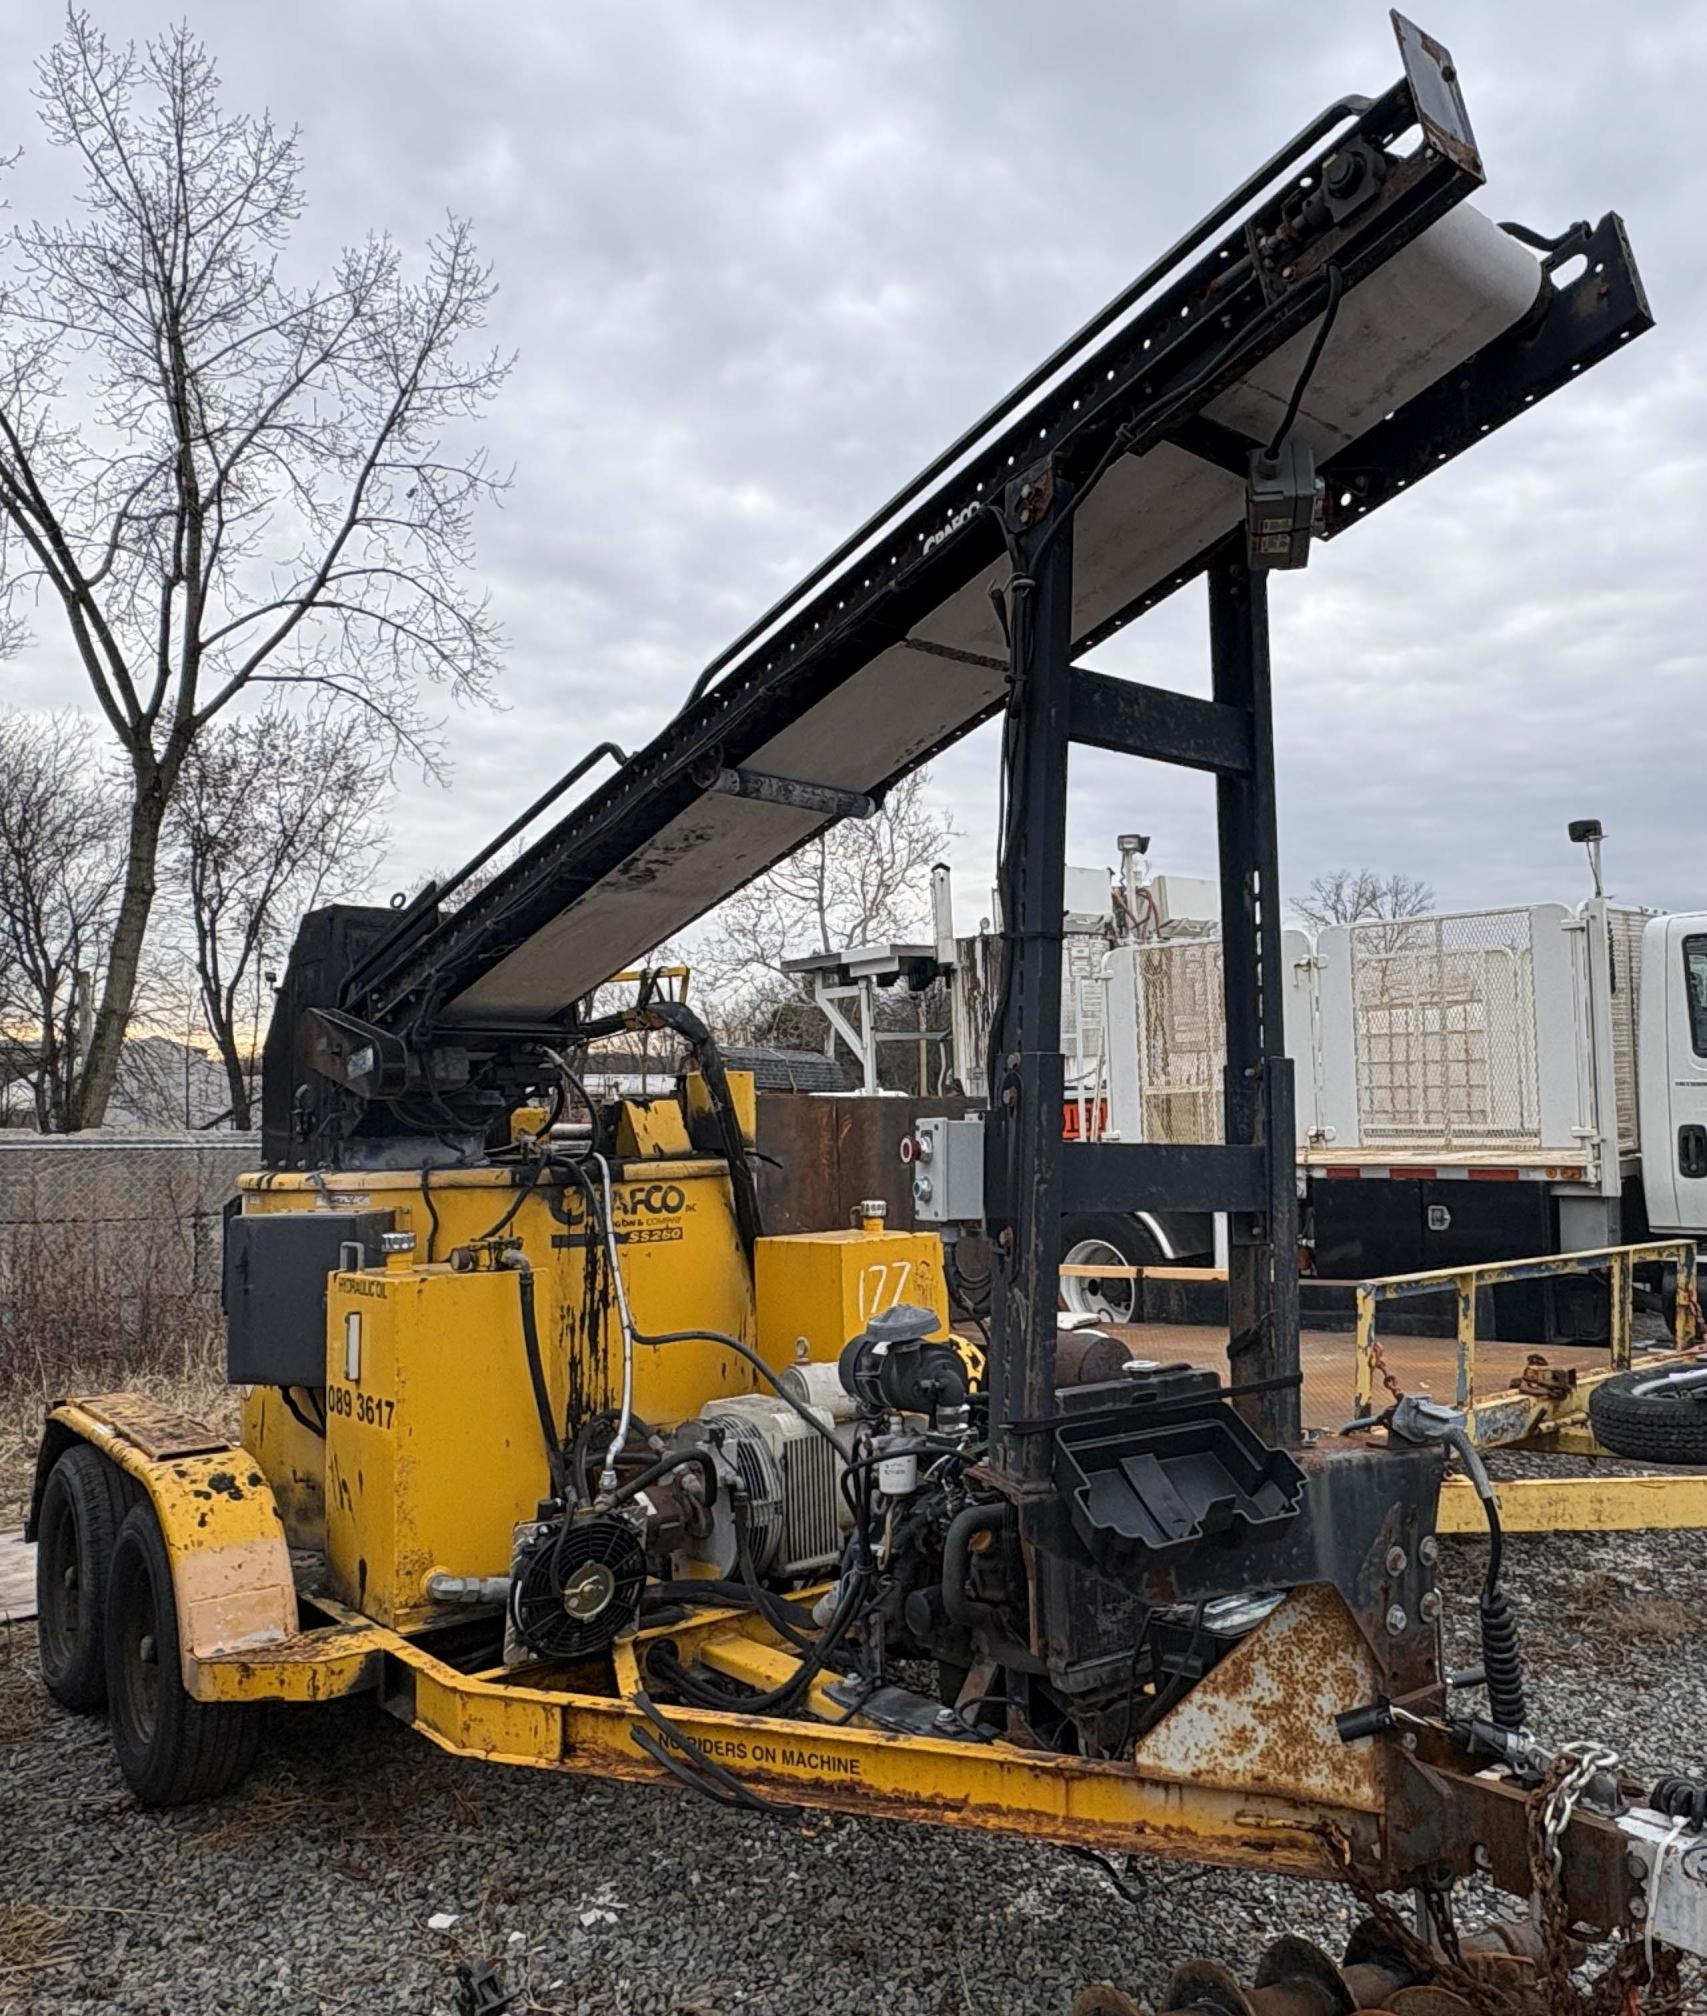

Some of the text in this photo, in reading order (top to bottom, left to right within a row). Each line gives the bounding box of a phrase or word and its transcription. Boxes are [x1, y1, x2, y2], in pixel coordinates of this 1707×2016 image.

[550, 1184, 686, 1225] CAFCO
[328, 1385, 395, 1430] 089 3617
[752, 1745, 777, 1764] ON
[781, 1749, 860, 1775] MACHINE
